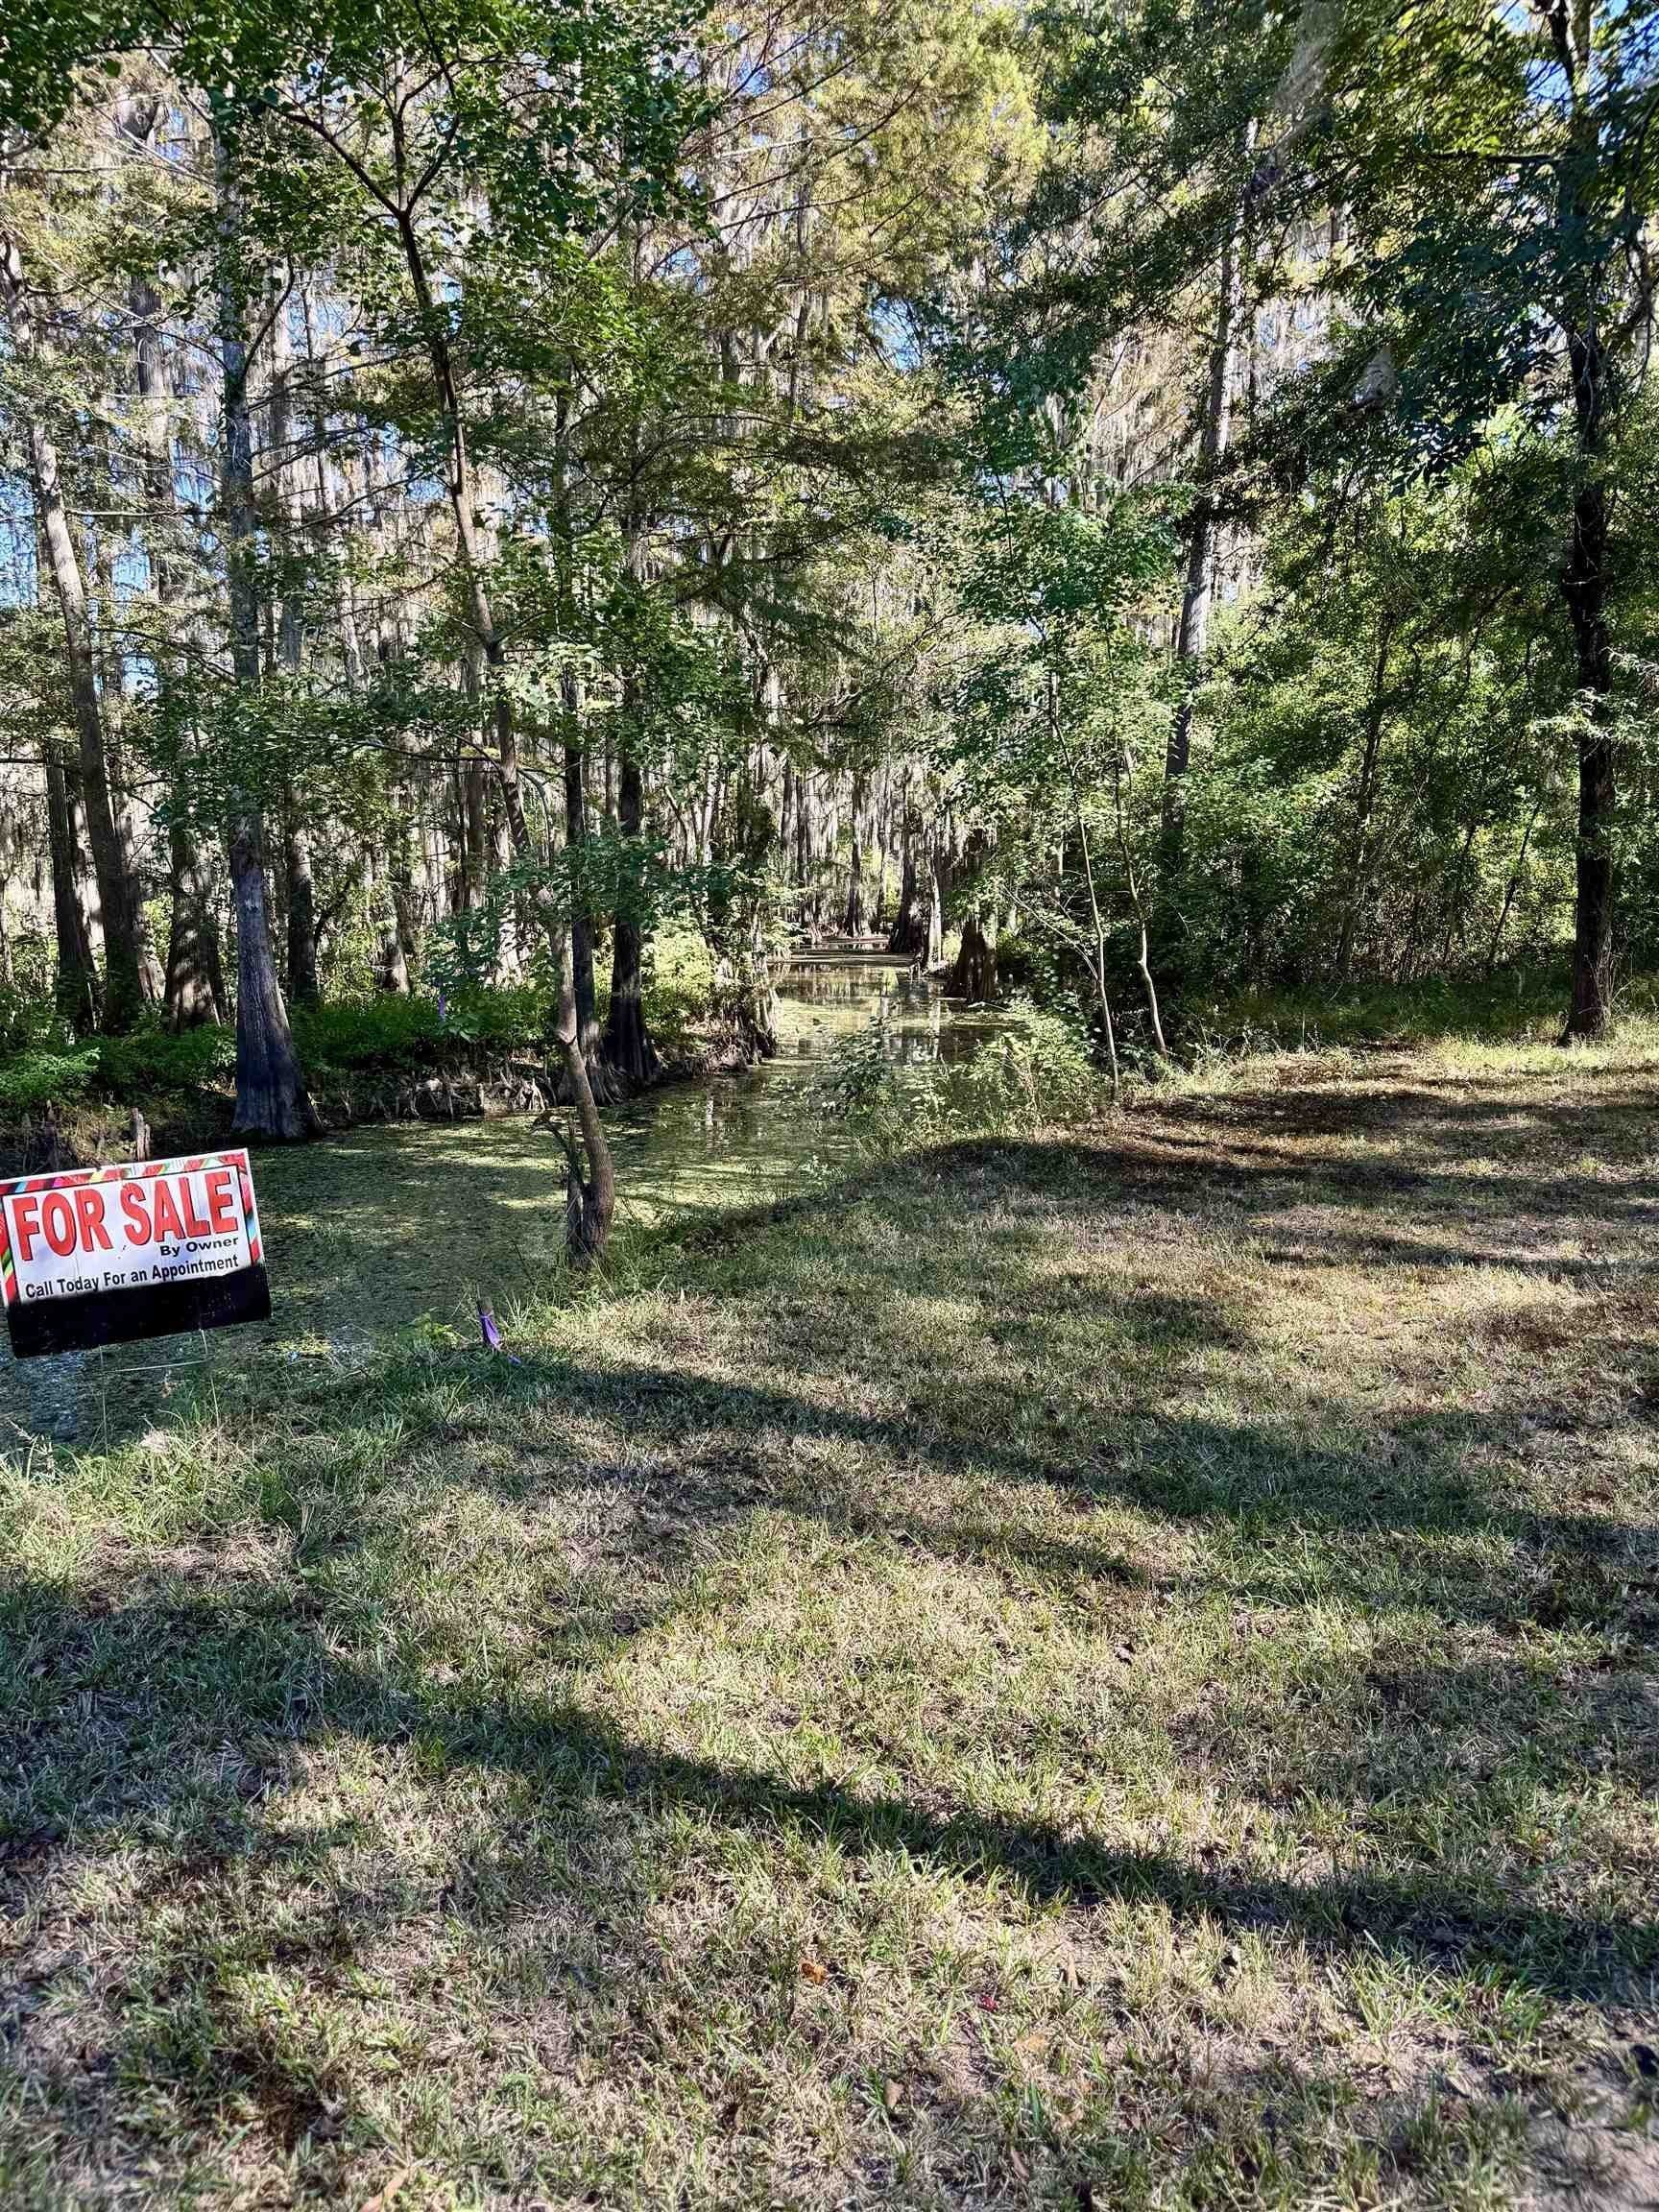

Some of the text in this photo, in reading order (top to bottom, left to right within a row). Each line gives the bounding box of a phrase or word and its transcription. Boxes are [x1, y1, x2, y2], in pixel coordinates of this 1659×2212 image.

[12, 1170, 238, 1262] FOR SALE
[159, 1237, 239, 1258] By Owner
[25, 1254, 239, 1298] Call Today For an Appointment
